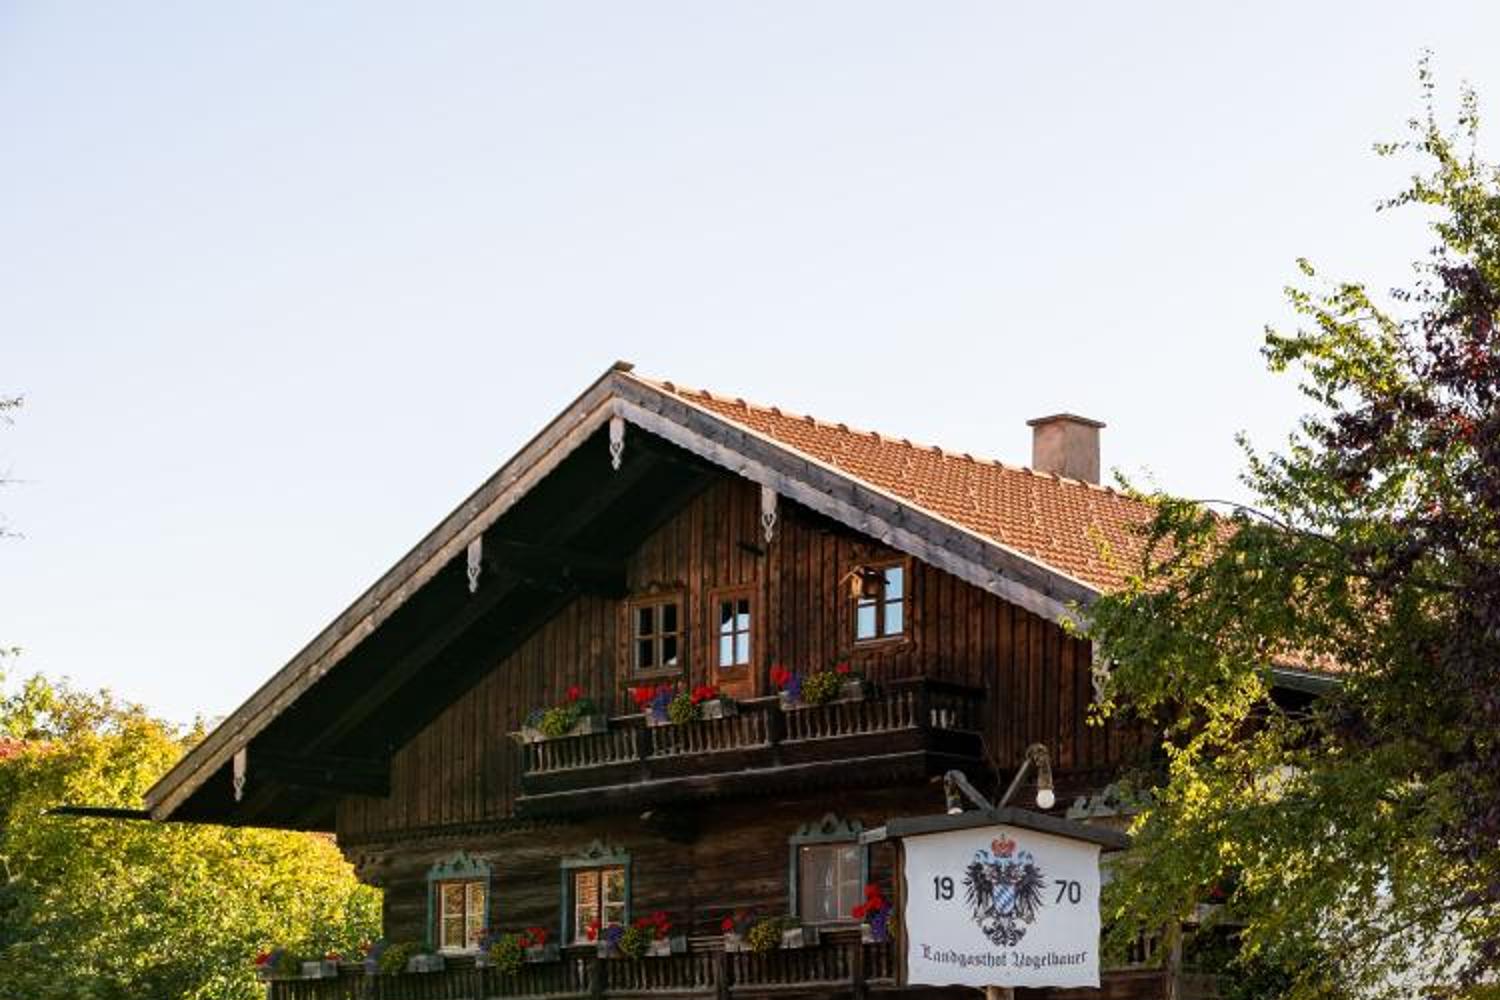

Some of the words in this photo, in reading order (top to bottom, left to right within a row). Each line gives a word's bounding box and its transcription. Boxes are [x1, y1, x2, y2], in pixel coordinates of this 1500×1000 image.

[933, 876, 955, 901] 19
[1055, 879, 1082, 905] 70
[920, 943, 1007, 968] Landgasthof
[1012, 950, 1088, 970] Vogelbauer
